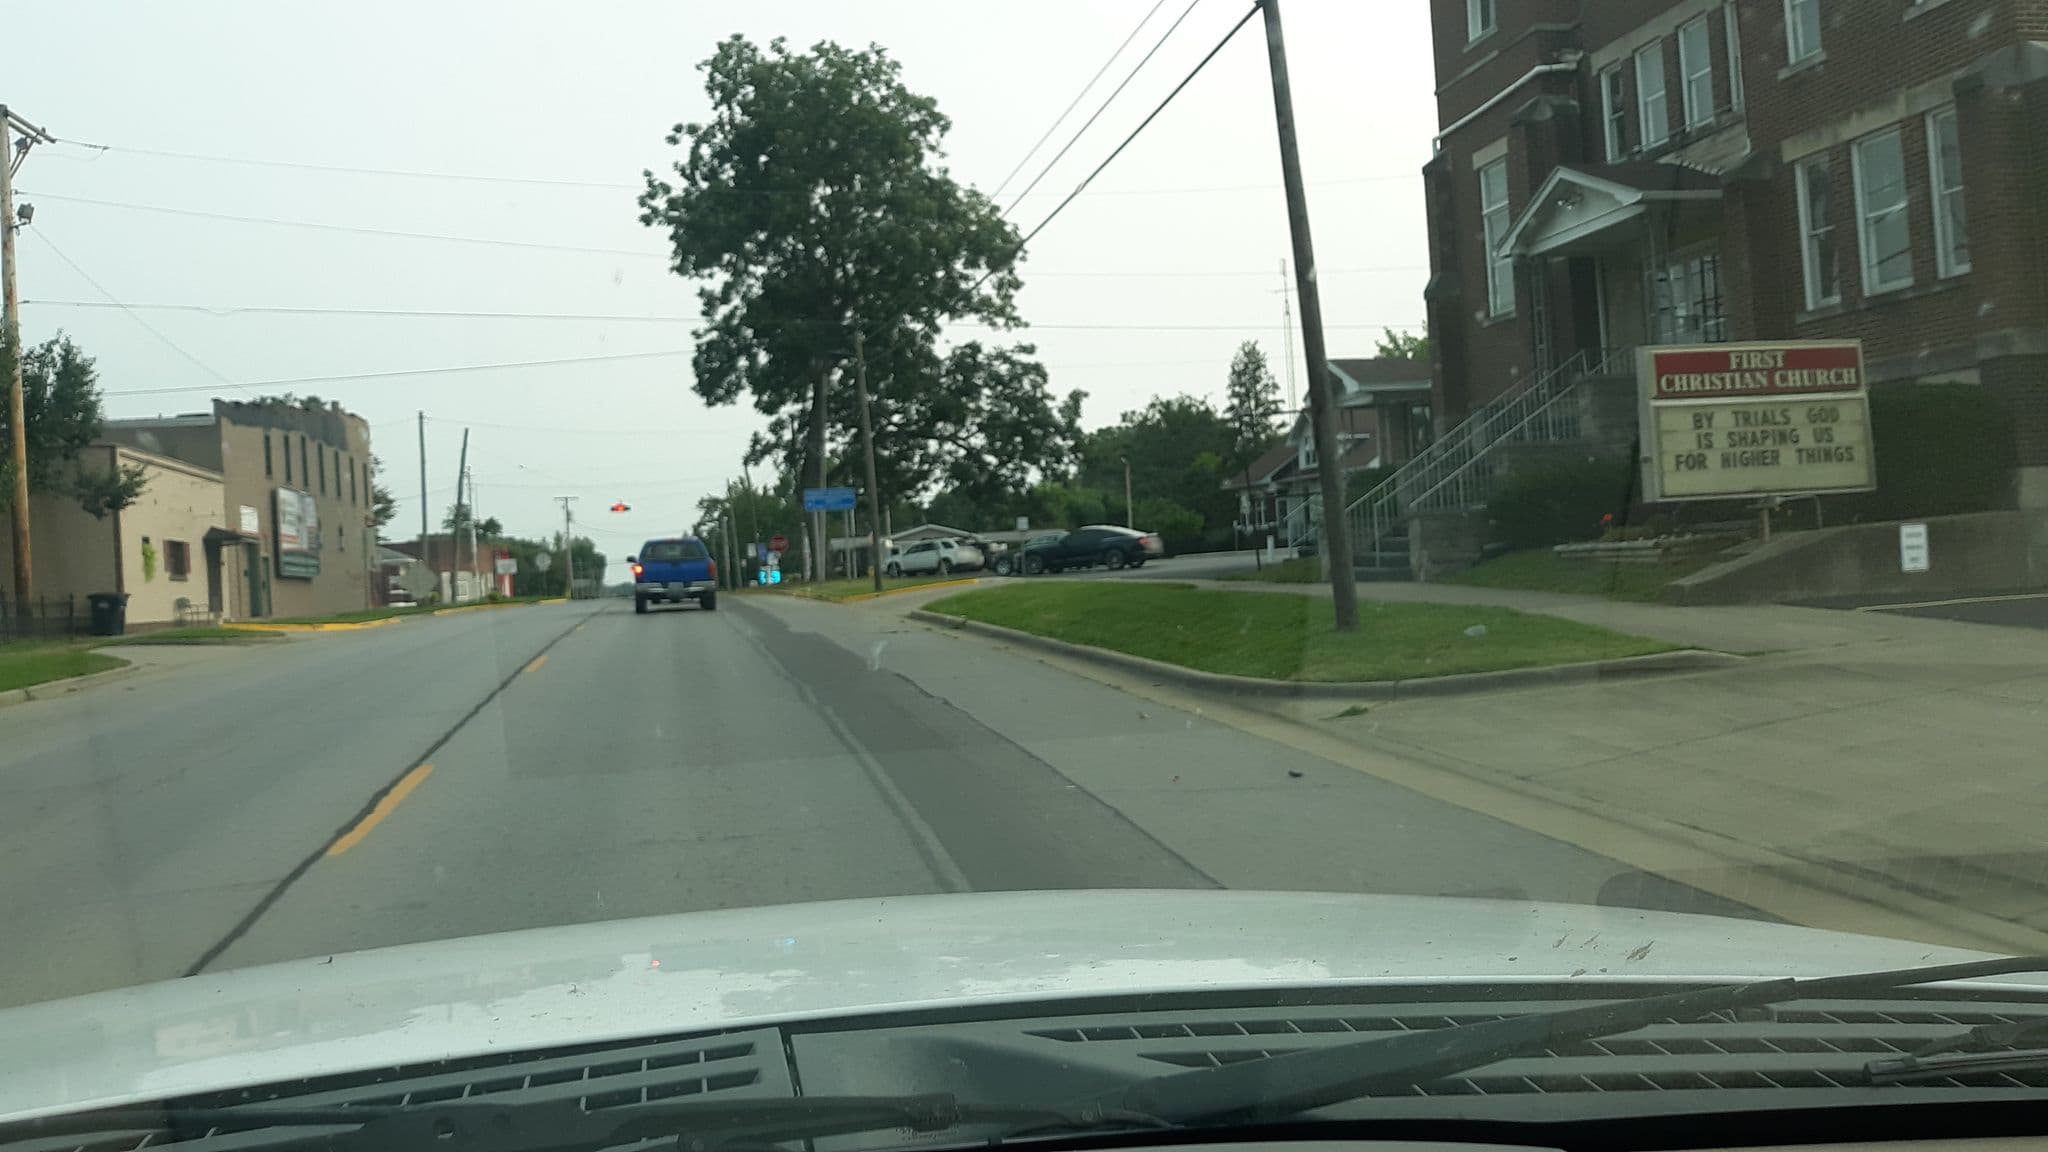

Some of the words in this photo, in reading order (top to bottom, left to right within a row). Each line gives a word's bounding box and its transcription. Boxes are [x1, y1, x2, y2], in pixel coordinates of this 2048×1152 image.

[1729, 350, 1786, 370] FIRST
[1661, 371, 1769, 392] CHRISTIAN
[1774, 367, 1857, 388] CHURCH
[1692, 411, 1715, 430] BY
[1731, 407, 1792, 427] TRIALS
[1805, 405, 1841, 424] GOD
[1696, 431, 1714, 449] IS
[1727, 428, 1801, 448] SHAPING
[1812, 426, 1835, 444] US
[1674, 452, 1708, 471] FOR
[1720, 448, 1781, 469] HIGHER
[1794, 445, 1855, 464] THINGS
